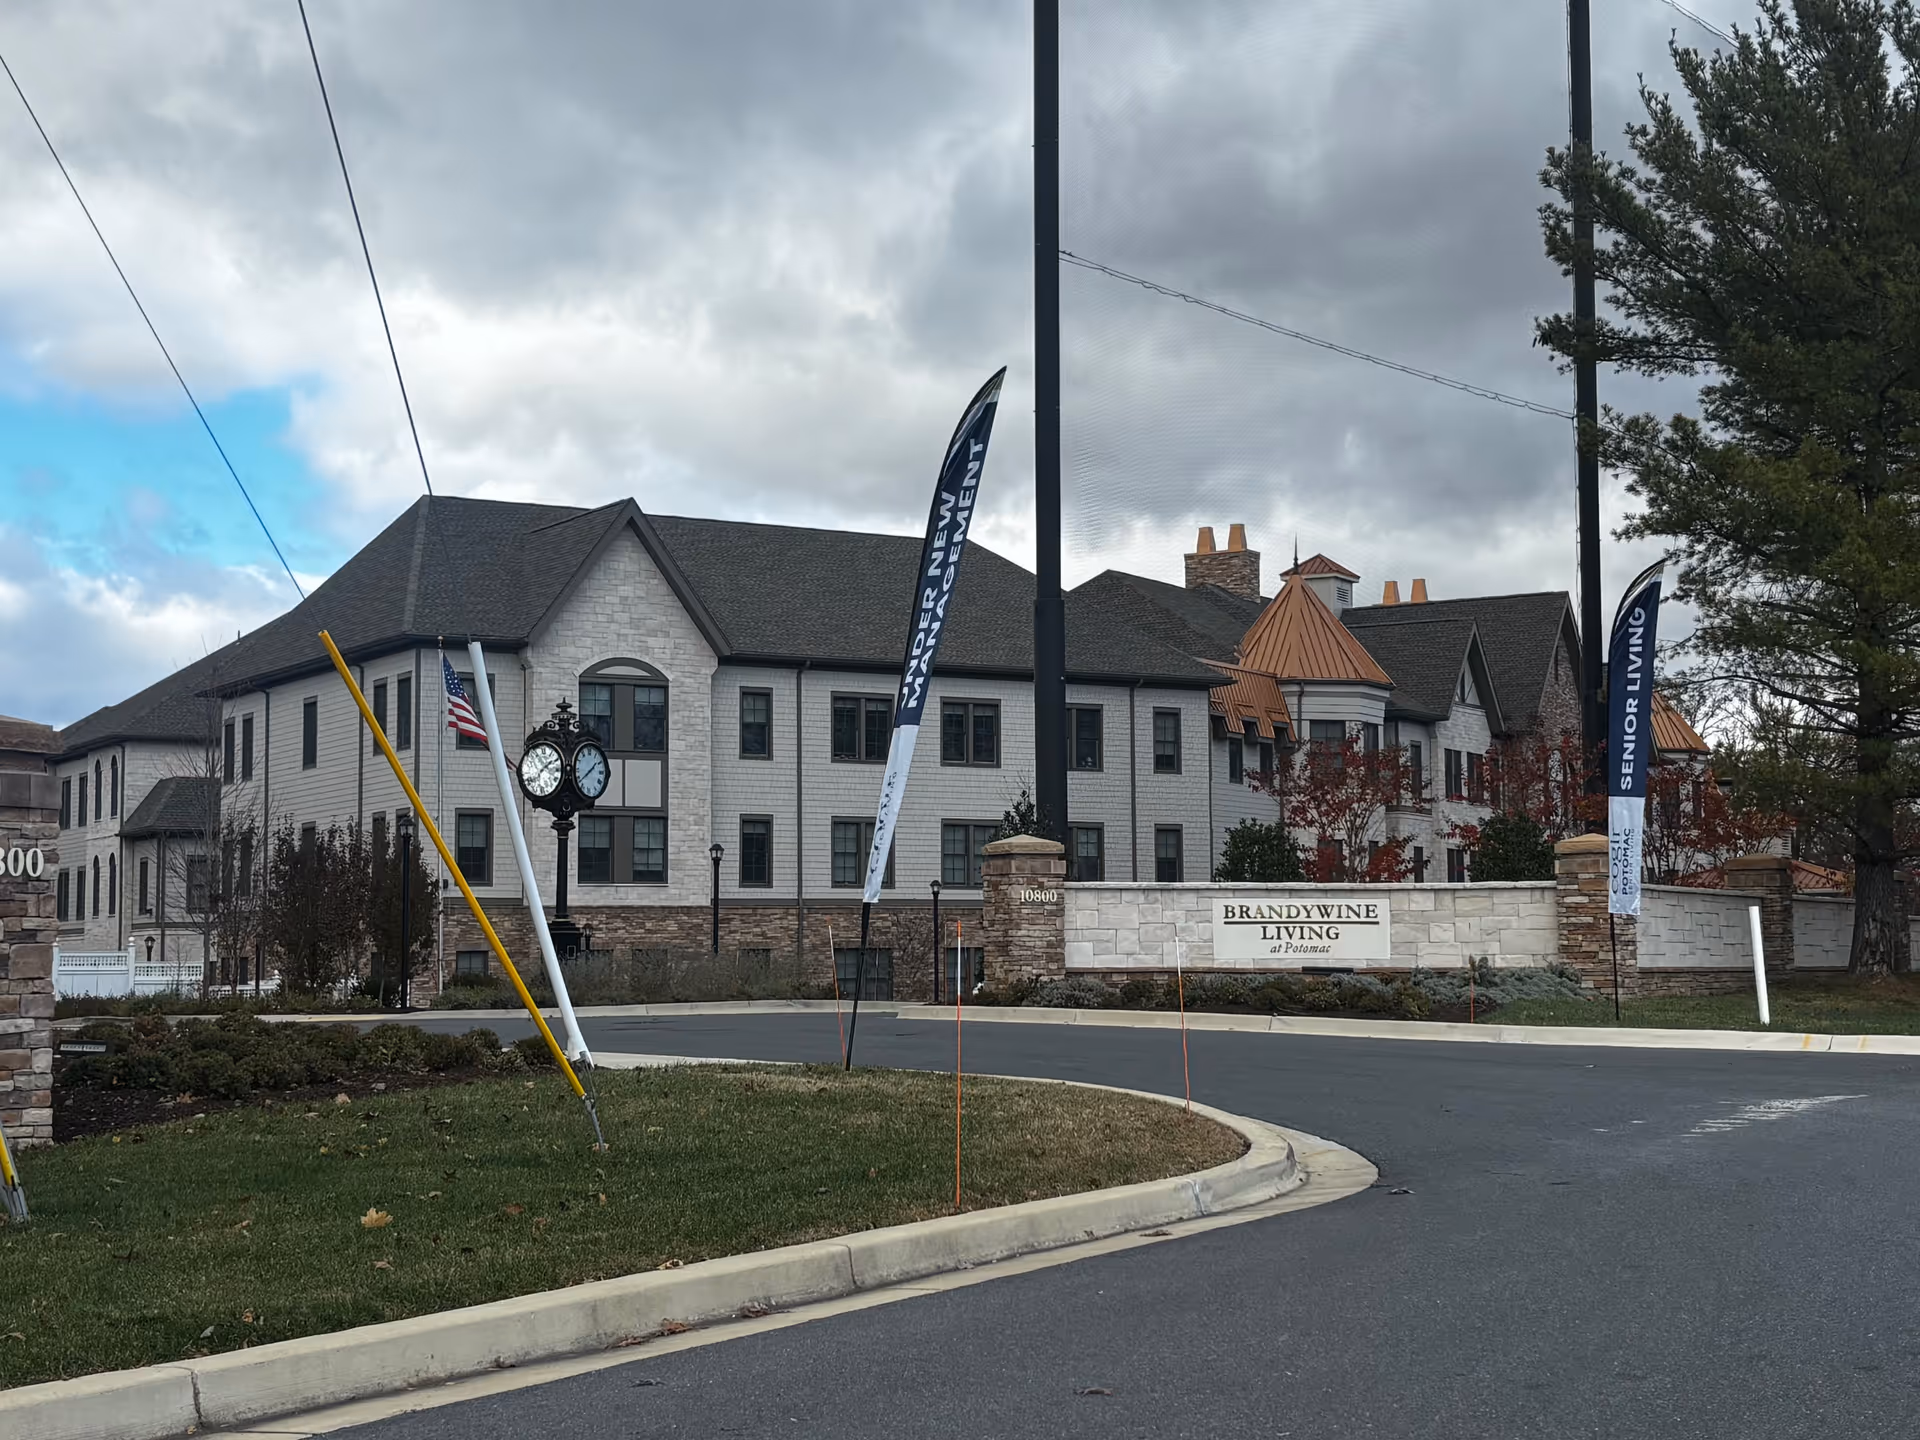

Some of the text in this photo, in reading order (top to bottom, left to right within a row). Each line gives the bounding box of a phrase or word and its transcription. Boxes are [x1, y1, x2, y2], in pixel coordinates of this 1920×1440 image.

[928, 491, 956, 576] NEW
[907, 438, 983, 708] MANAGEMENT
[1621, 606, 1646, 790] SENIOR LIVING
[1622, 828, 1631, 895] POTOMAC
[1020, 889, 1057, 902] 10800
[1223, 904, 1378, 919] BRANDYWINE
[1260, 926, 1340, 940] LIVING
[1270, 942, 1331, 954] at Potomac
